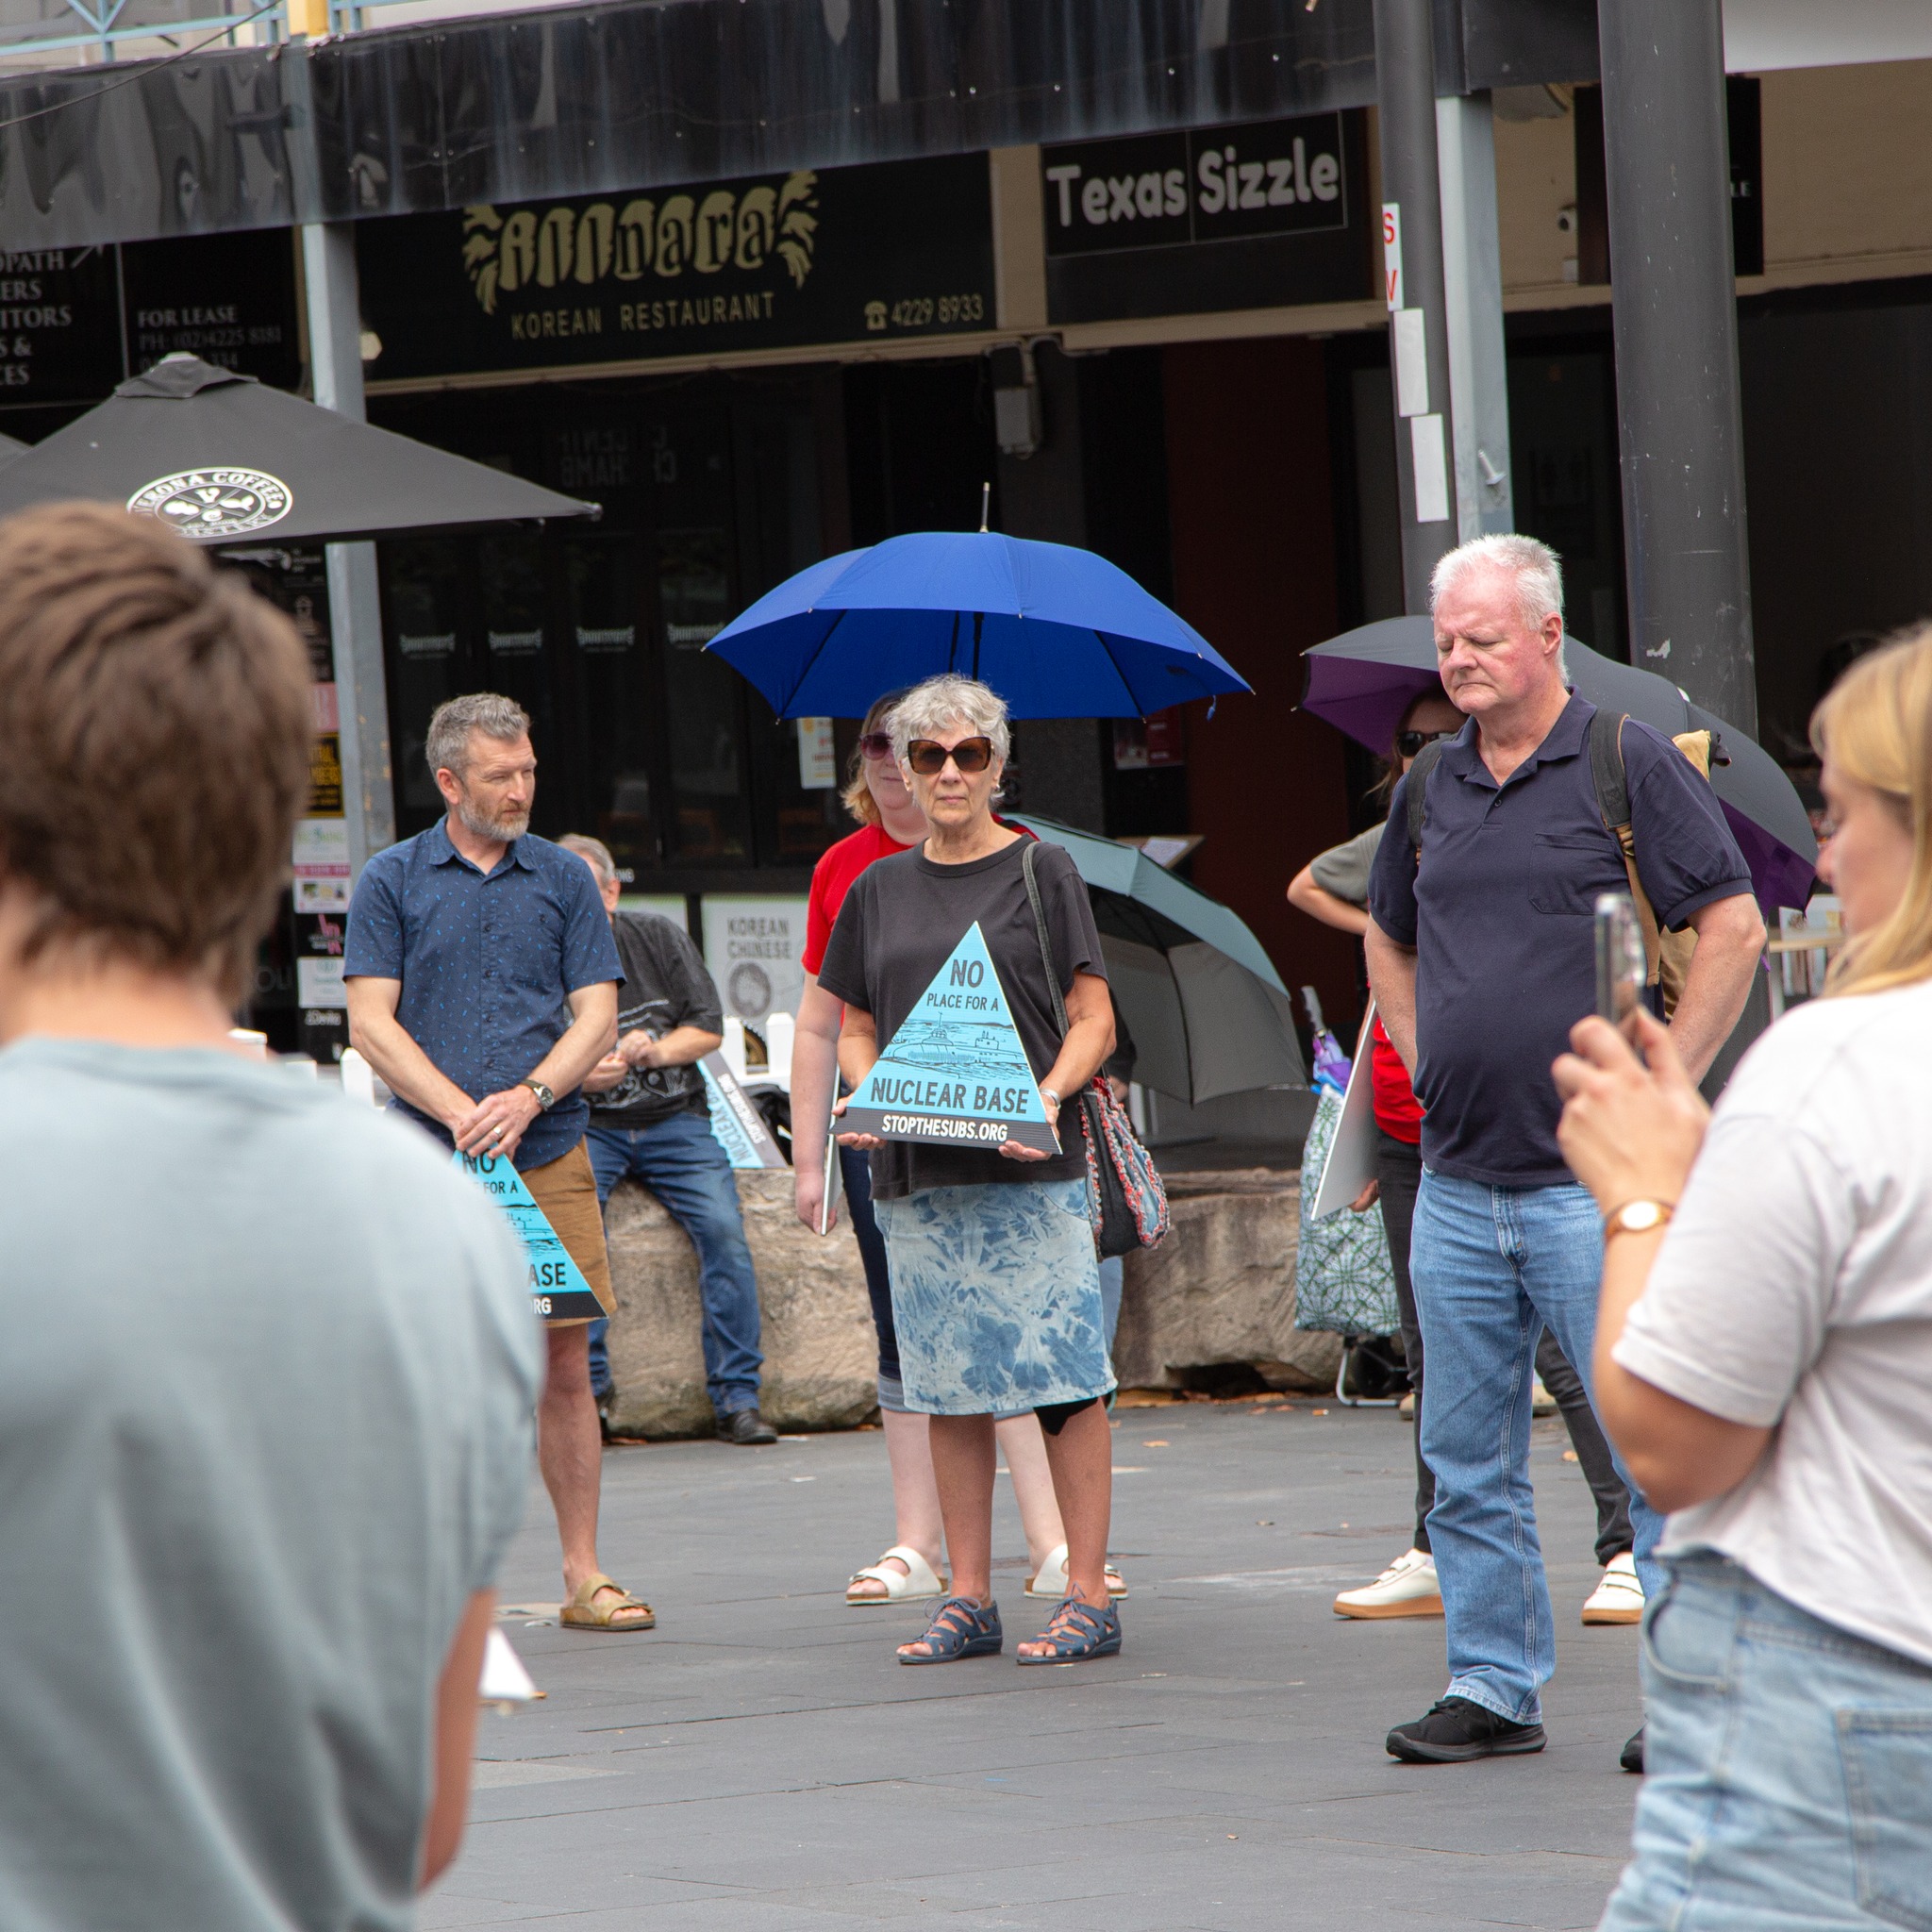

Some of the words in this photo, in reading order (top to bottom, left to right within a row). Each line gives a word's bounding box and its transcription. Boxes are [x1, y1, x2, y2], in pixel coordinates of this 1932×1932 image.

[1045, 163, 1188, 227] Texas
[1197, 136, 1340, 214] Sizzle
[0, 250, 65, 274] PATH
[137, 308, 178, 328] FOR
[181, 305, 238, 325] LEASE
[510, 307, 603, 341] KOREAN
[620, 291, 775, 332] RESTAURANT
[891, 298, 934, 326] 4229
[938, 292, 984, 324] 8933
[0, 362, 31, 386] ES
[726, 916, 790, 938] KOREAN
[726, 940, 792, 960] CHINESE
[949, 958, 984, 988] NO
[926, 993, 961, 1009] PLACE
[965, 995, 987, 1010] FOR
[991, 997, 999, 1011] A
[871, 1077, 966, 1109] NUCLEAR
[974, 1085, 1030, 1114] BASE
[881, 1114, 1008, 1142] STOPTHESUBS.ORG
[461, 1148, 496, 1174] NO
[483, 1181, 506, 1195] FOR
[509, 1180, 519, 1194] A
[528, 1262, 567, 1288] ASE
